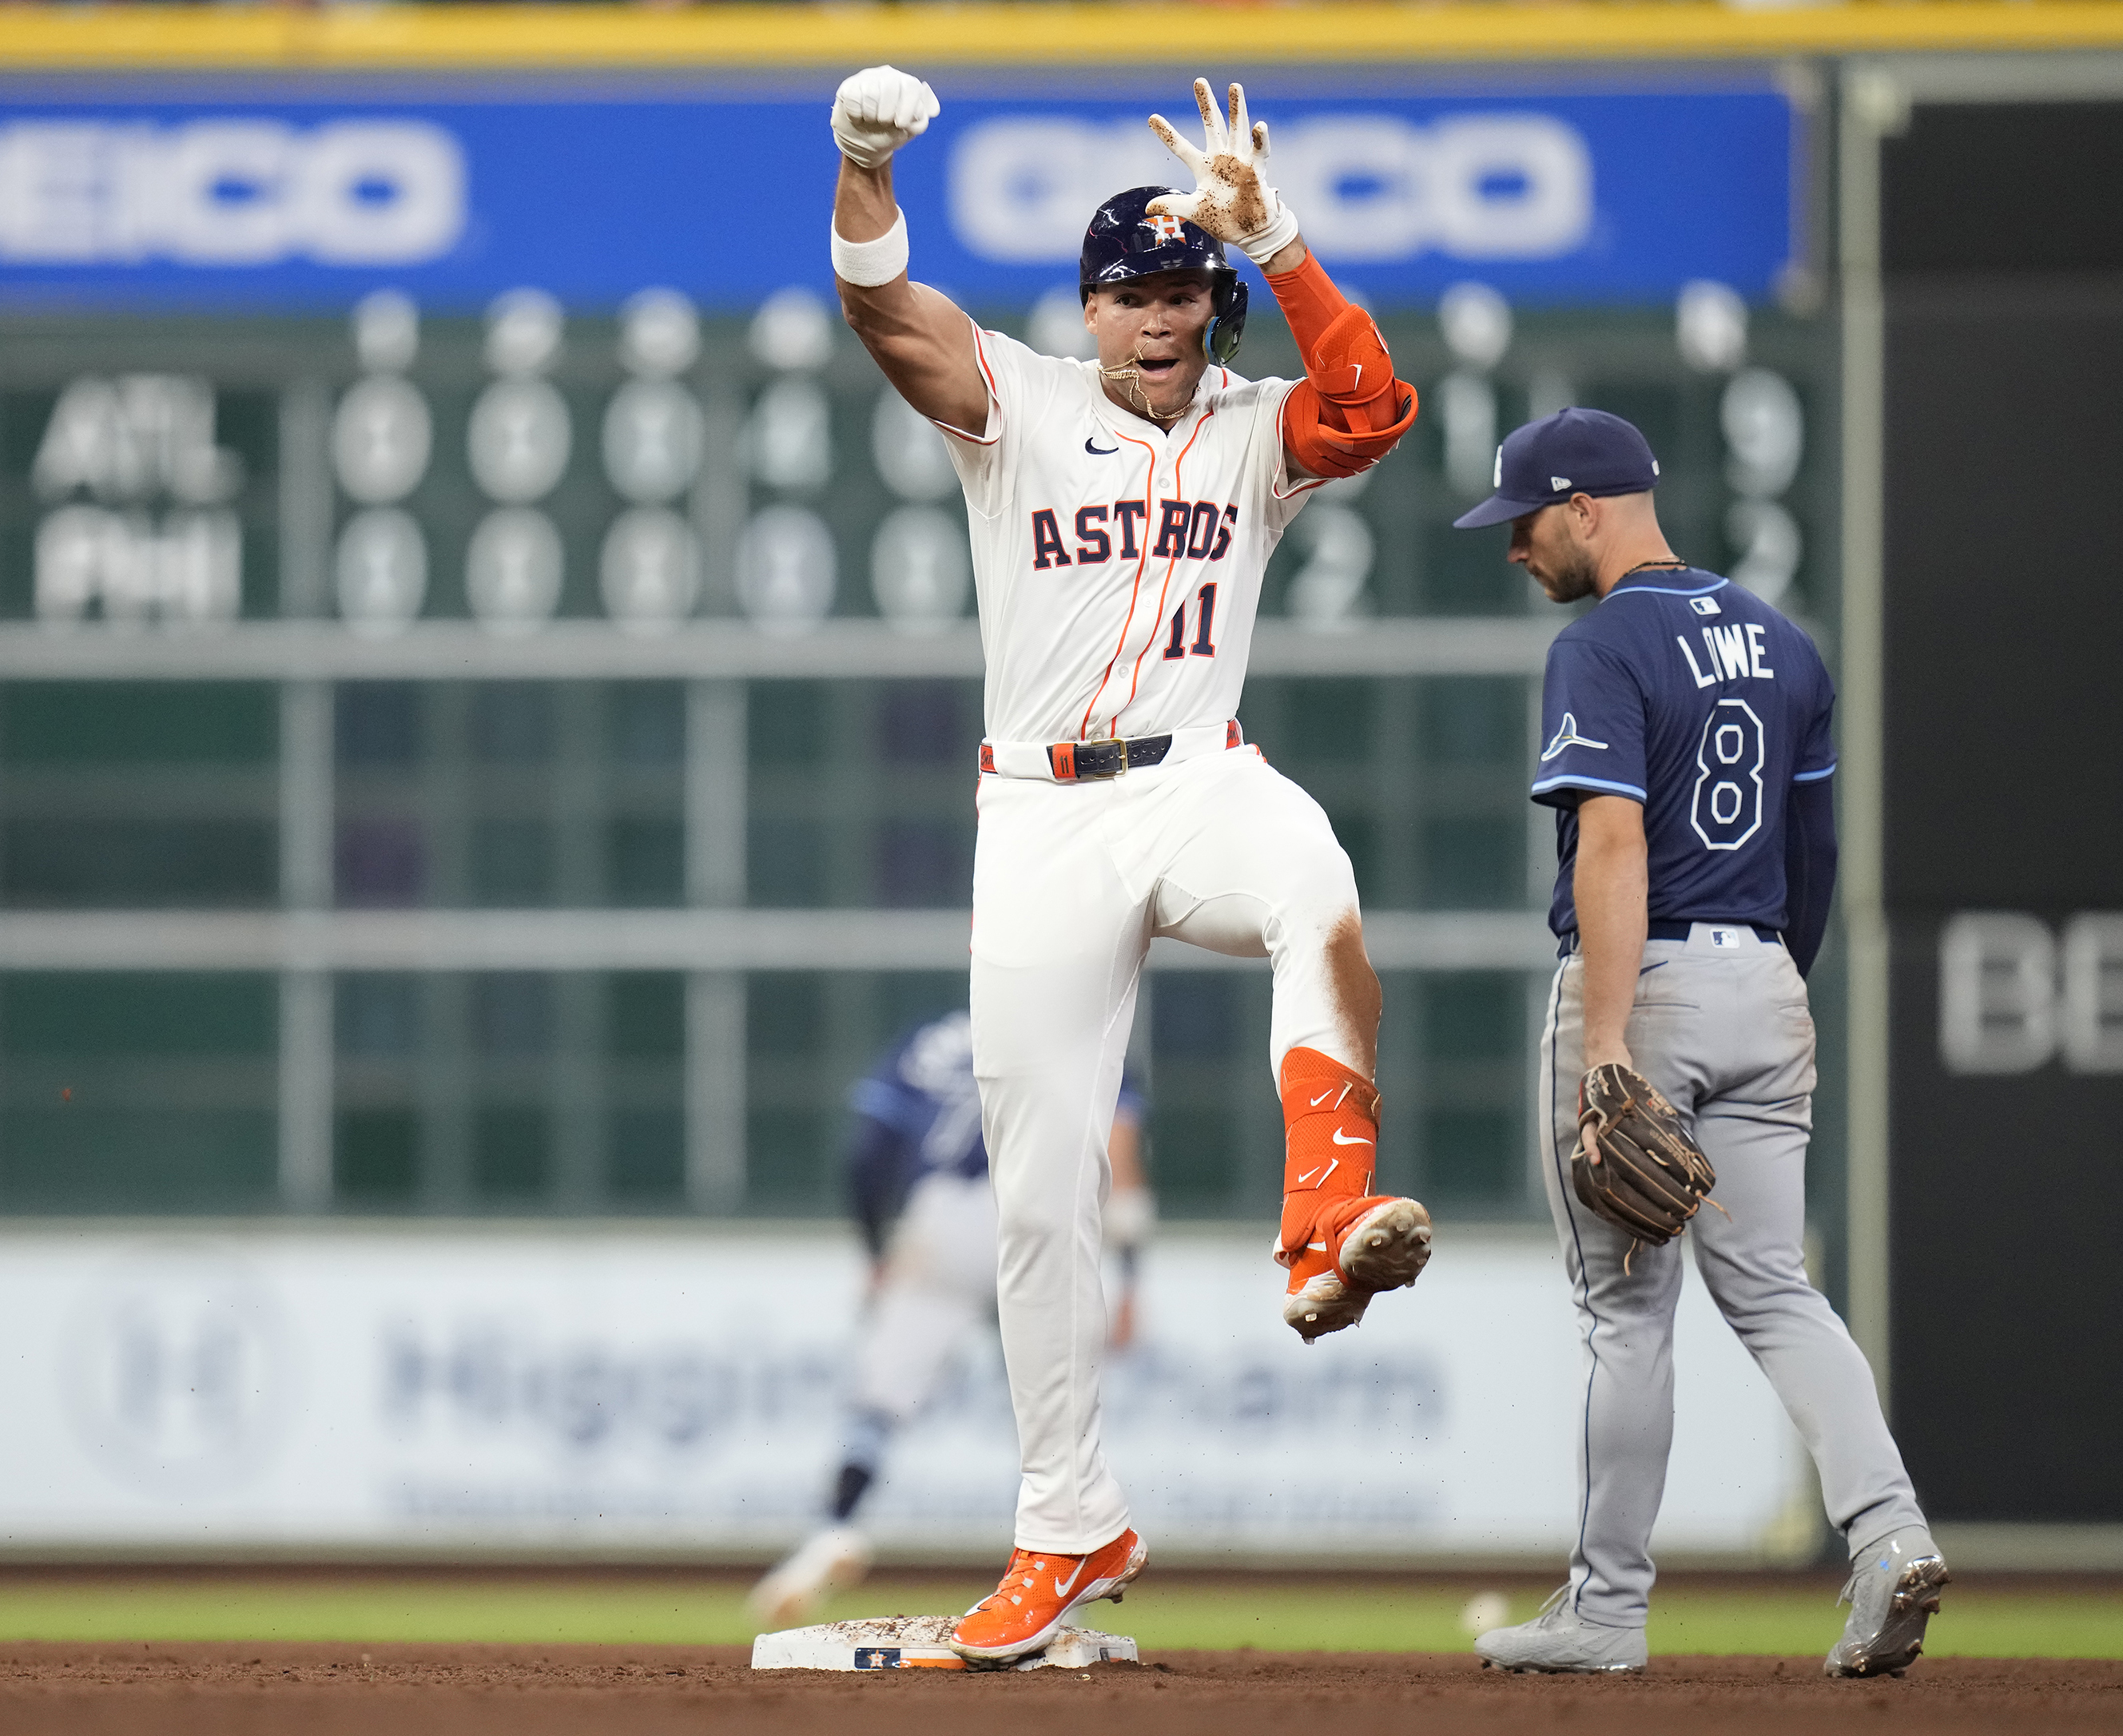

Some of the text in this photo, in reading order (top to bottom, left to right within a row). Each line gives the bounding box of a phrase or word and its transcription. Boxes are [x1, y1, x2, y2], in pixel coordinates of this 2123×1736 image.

[1032, 498, 1238, 571] ASTROS
[1163, 582, 1218, 661] 11
[1677, 623, 1774, 689] LOWE
[1060, 755, 1069, 774] 11
[1690, 698, 1764, 851] 8
